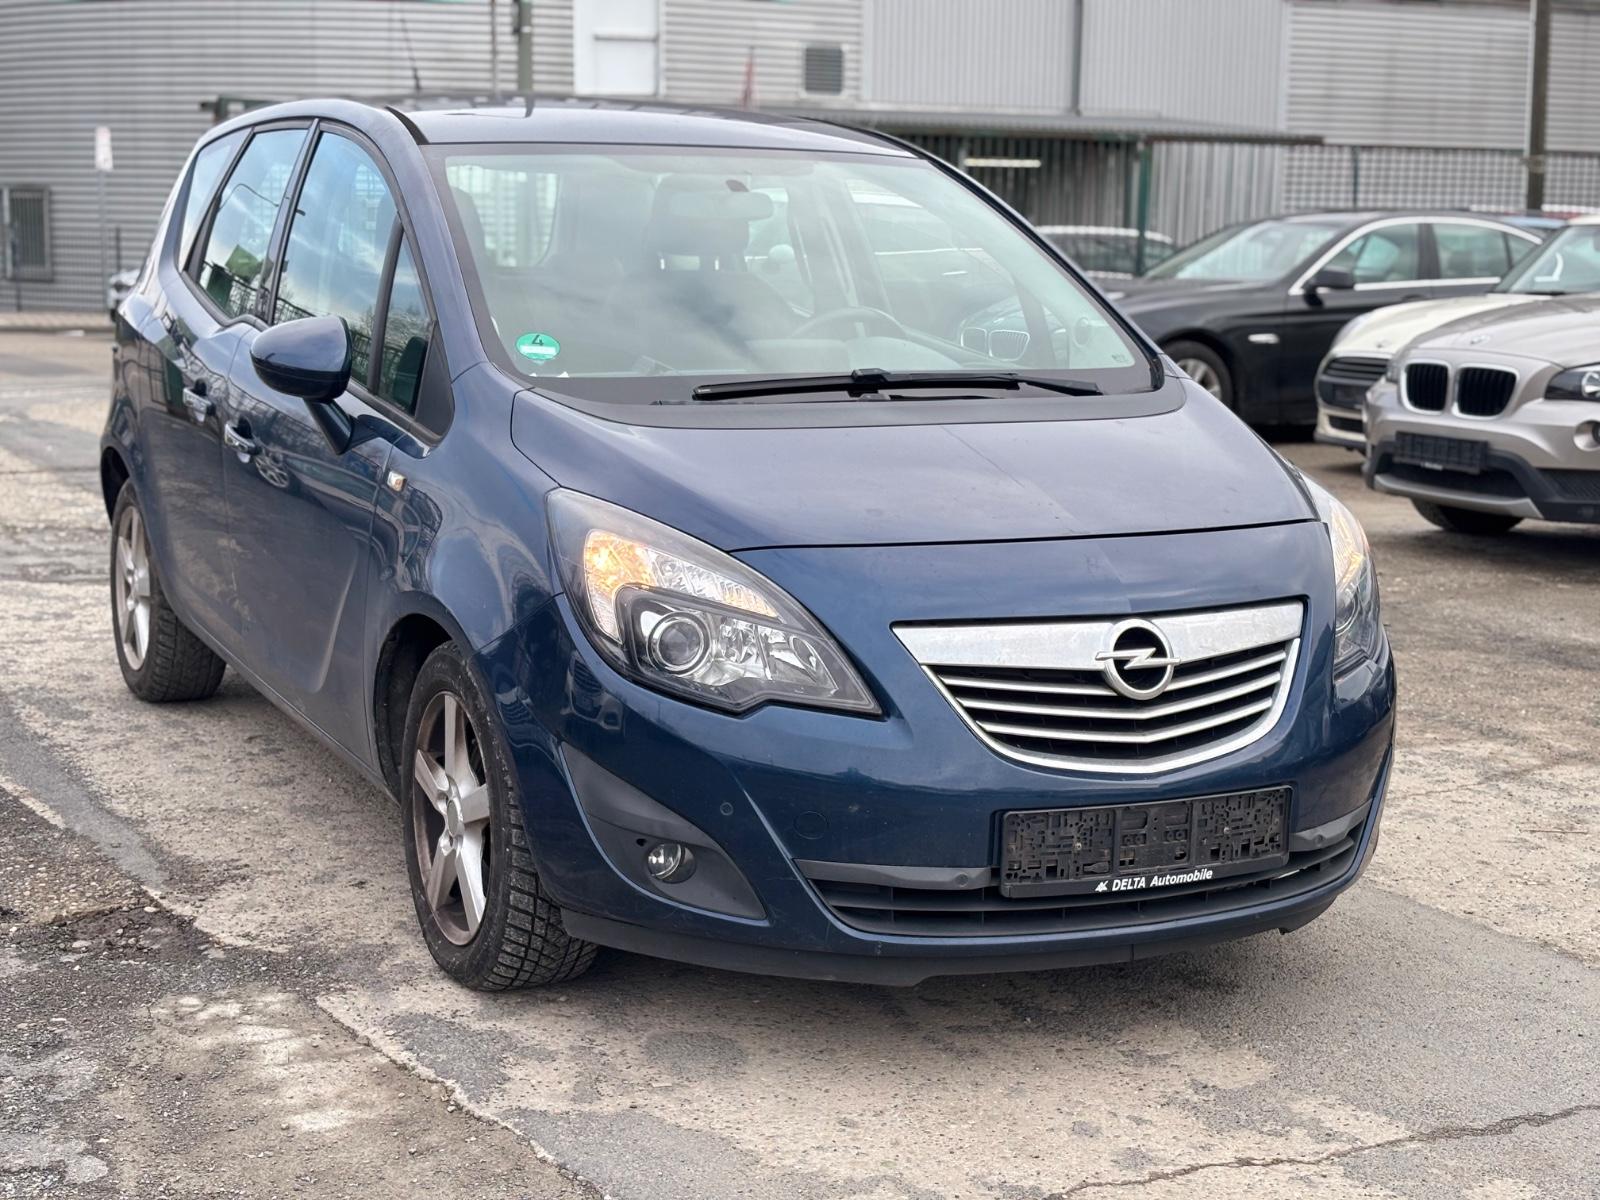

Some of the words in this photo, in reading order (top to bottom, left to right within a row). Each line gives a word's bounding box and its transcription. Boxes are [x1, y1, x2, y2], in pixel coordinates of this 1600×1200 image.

[531, 334, 544, 346] 4
[1112, 877, 1146, 891] DELTA
[1150, 868, 1213, 887] Automobile
